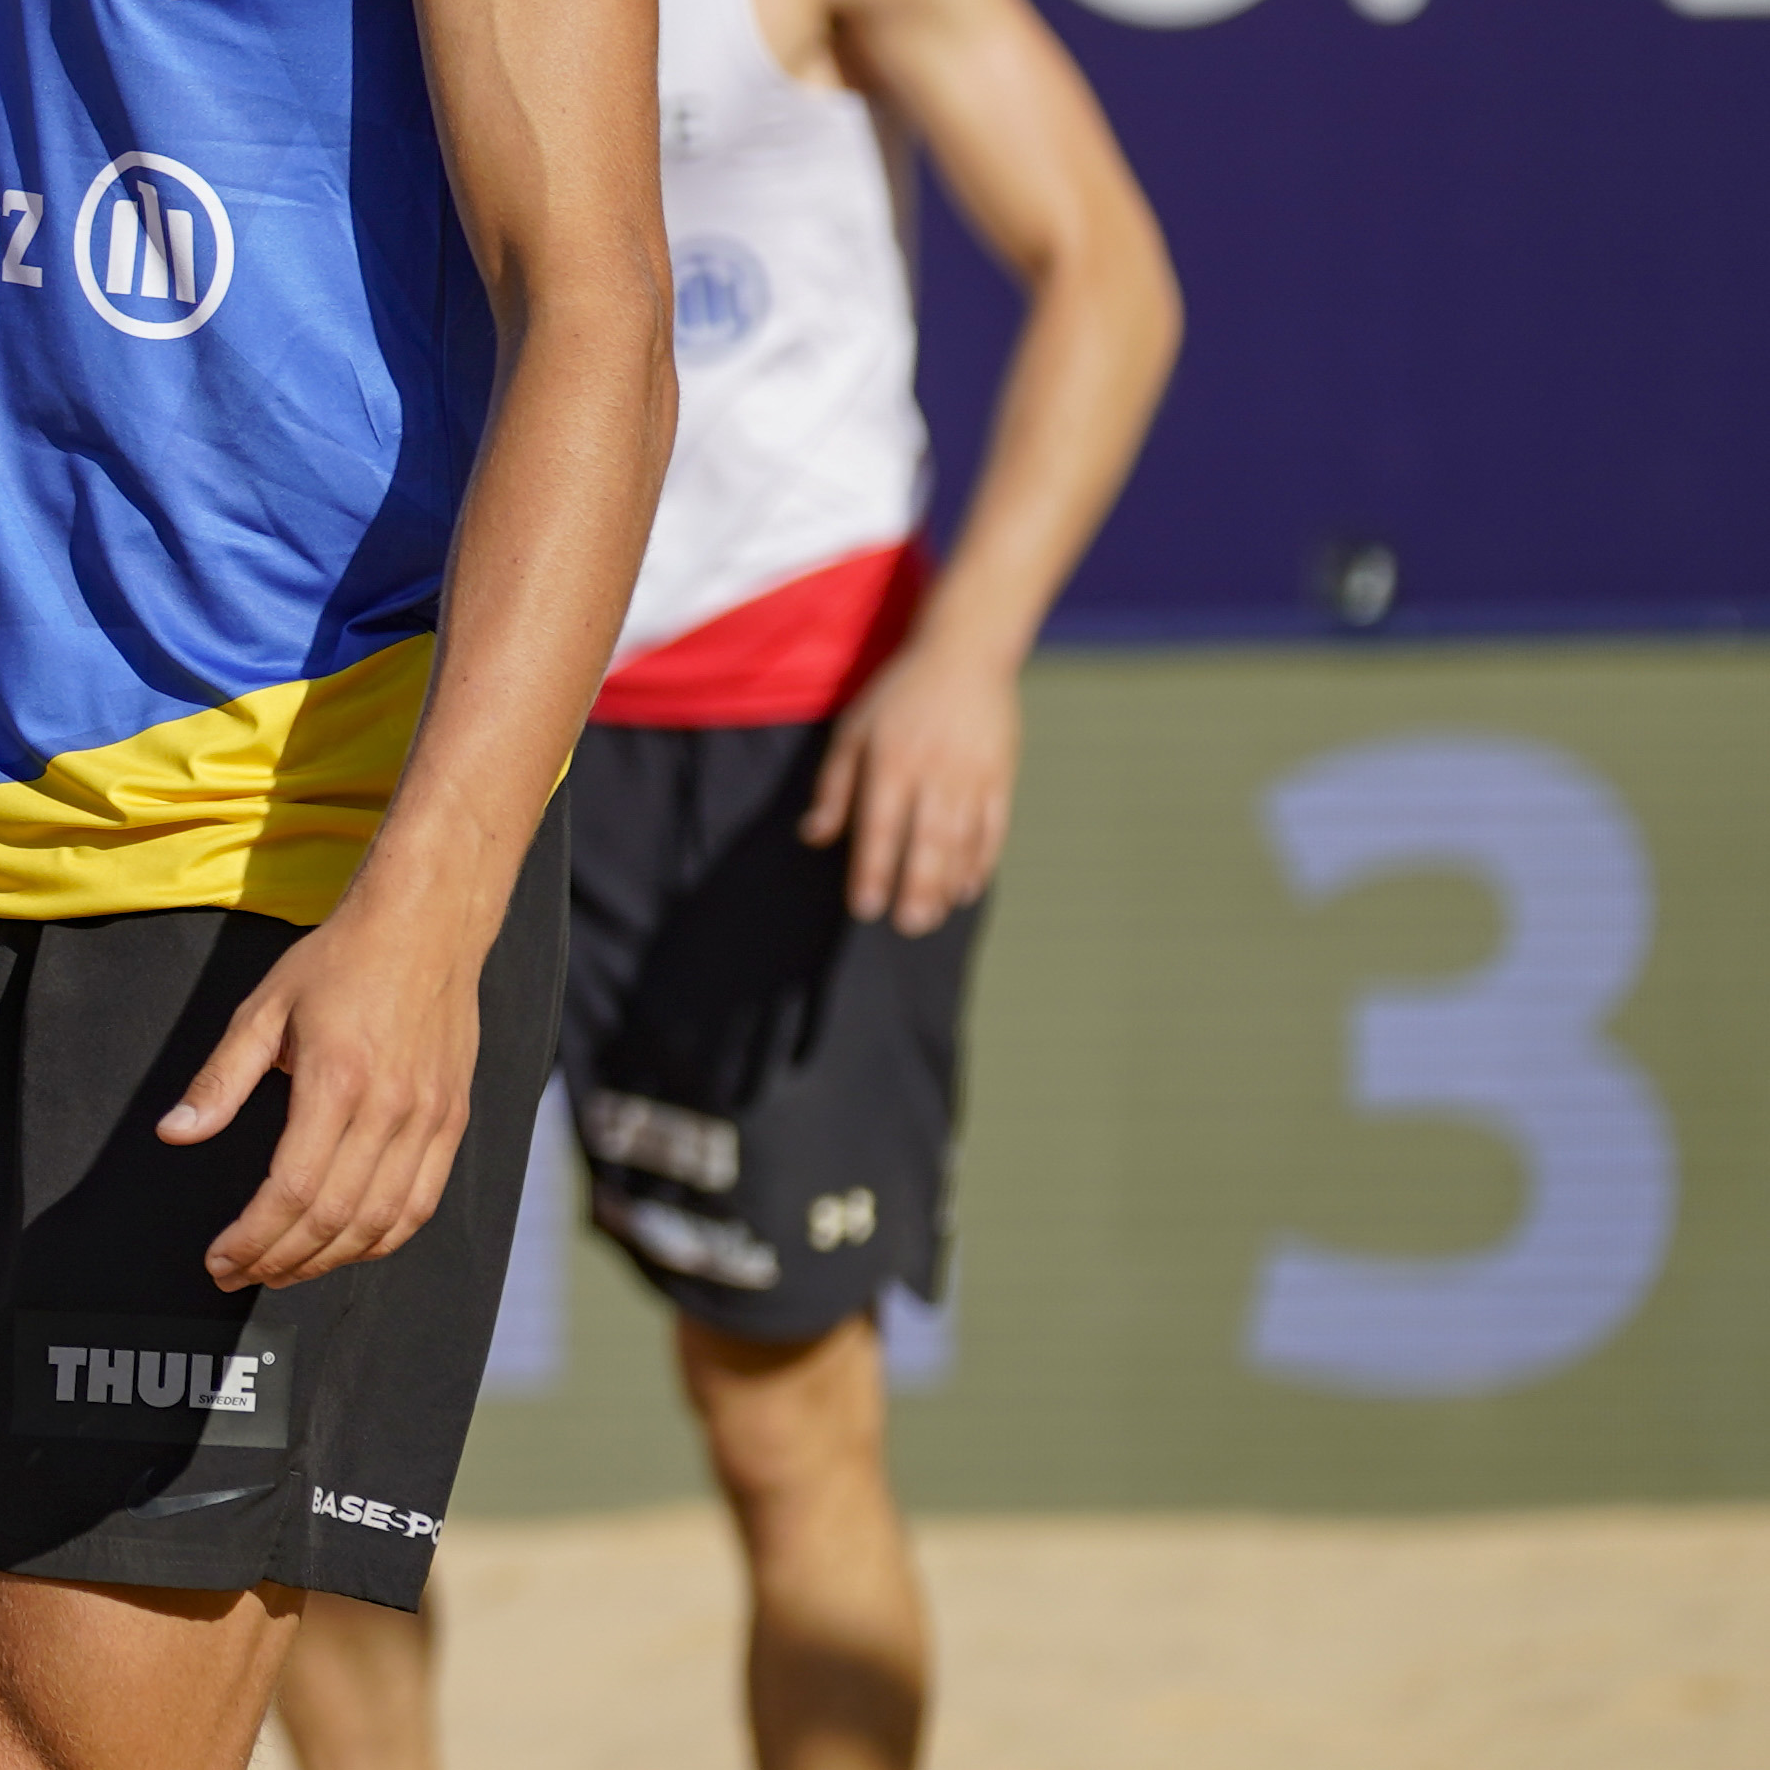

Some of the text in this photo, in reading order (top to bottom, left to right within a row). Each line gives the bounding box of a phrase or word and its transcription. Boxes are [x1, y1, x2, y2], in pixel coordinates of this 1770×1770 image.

[1245, 722, 1684, 1402] 3
[48, 1346, 259, 1413] THULE
[198, 1394, 248, 1407] SWEDEN
